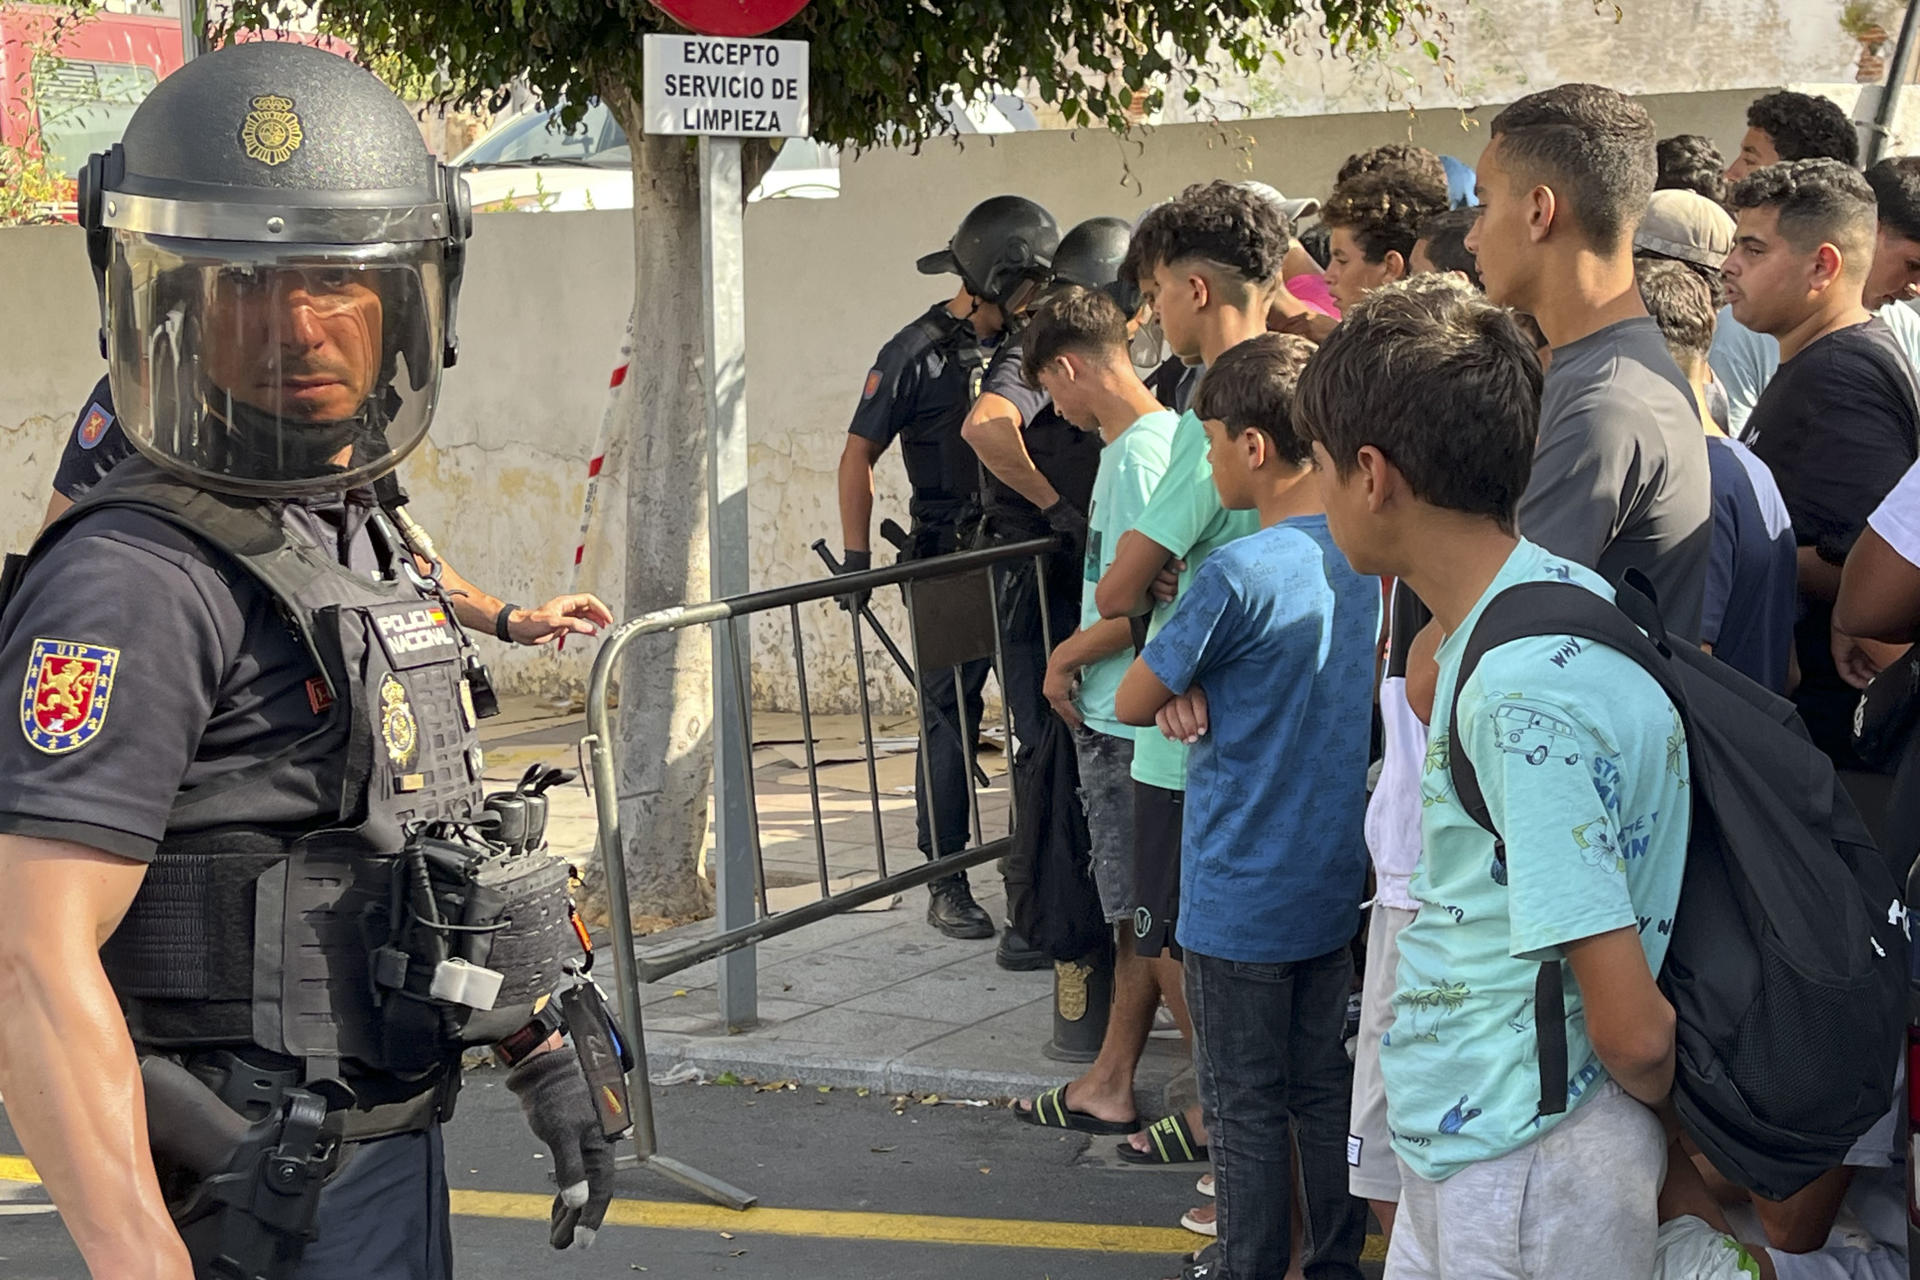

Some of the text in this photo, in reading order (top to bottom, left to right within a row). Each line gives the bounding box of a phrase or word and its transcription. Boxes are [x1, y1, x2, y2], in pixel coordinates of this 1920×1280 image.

[683, 41, 779, 67] EXCEPTO
[664, 74, 798, 100] SERVICIO DE
[683, 108, 781, 132] LIMPIEZA
[377, 609, 437, 635] POLICIA
[56, 643, 89, 659] UIP
[1549, 635, 1582, 669] WHY
